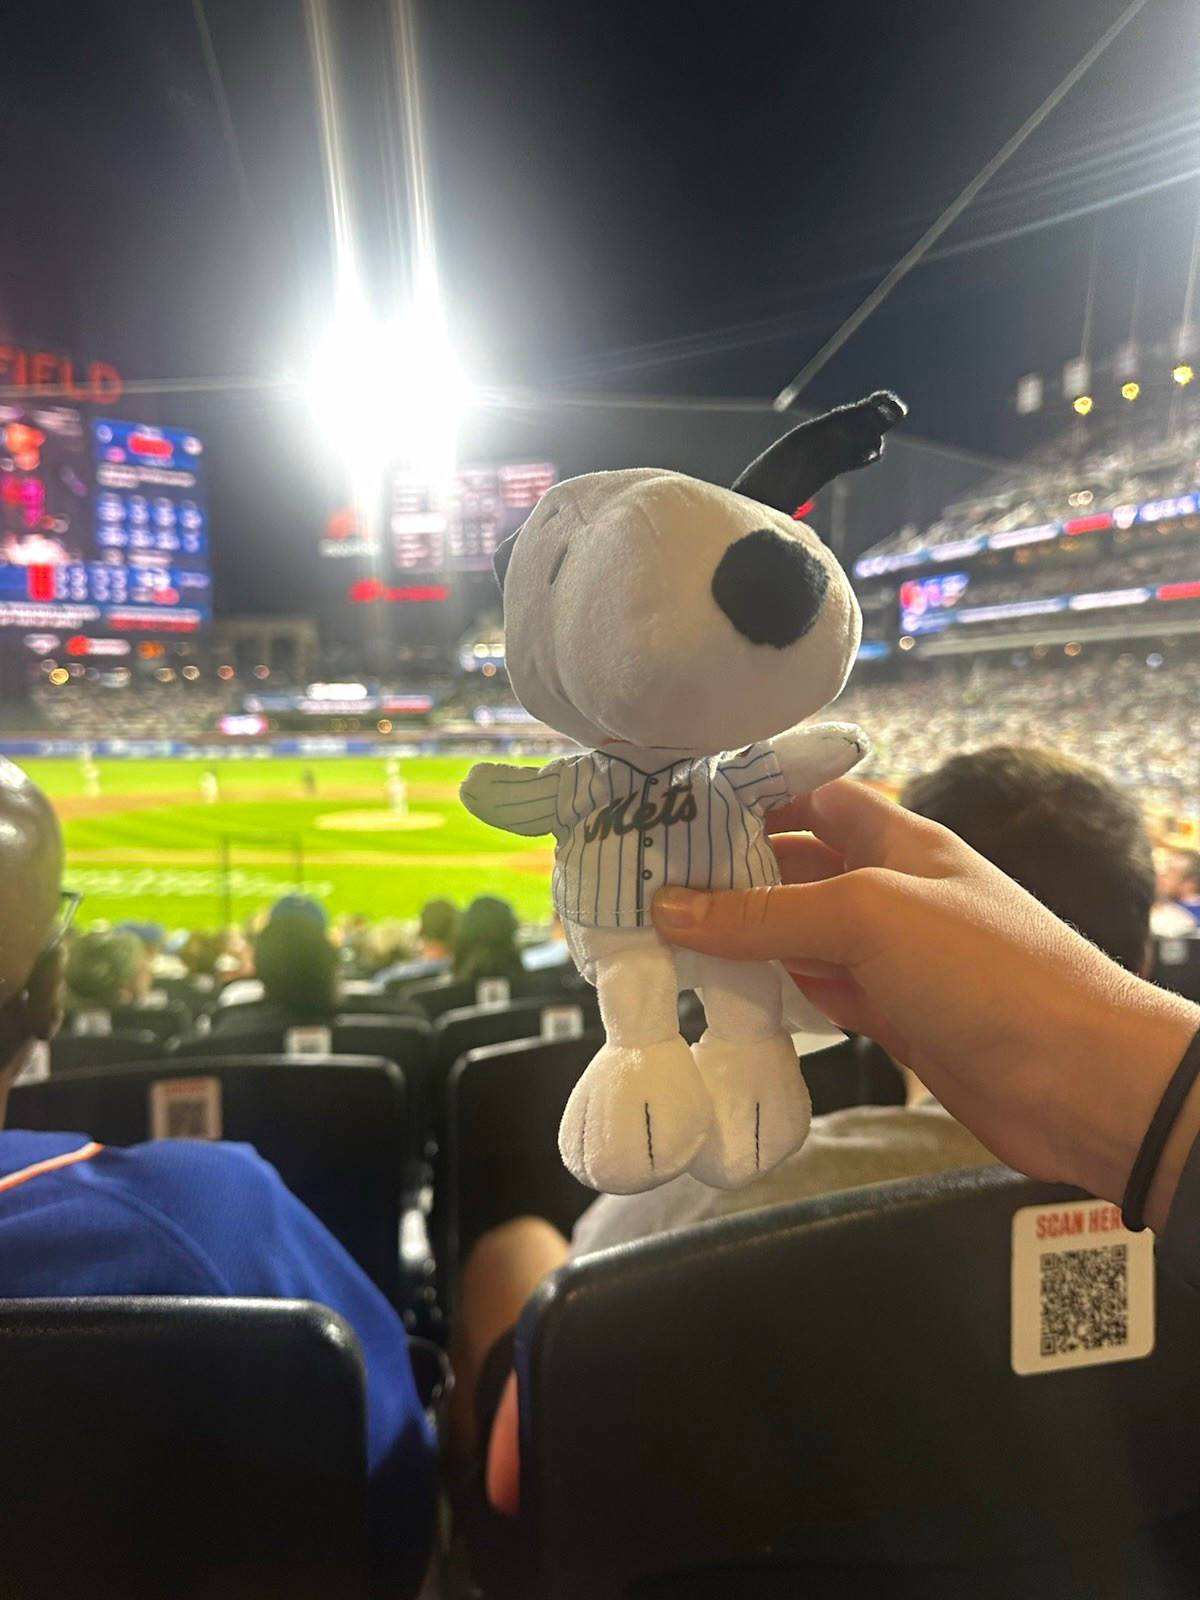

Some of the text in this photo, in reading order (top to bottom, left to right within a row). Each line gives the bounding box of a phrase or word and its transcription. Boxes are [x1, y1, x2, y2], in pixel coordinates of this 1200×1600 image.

[584, 784, 697, 843] Mets
[1036, 1207, 1122, 1239] SCAN HER
